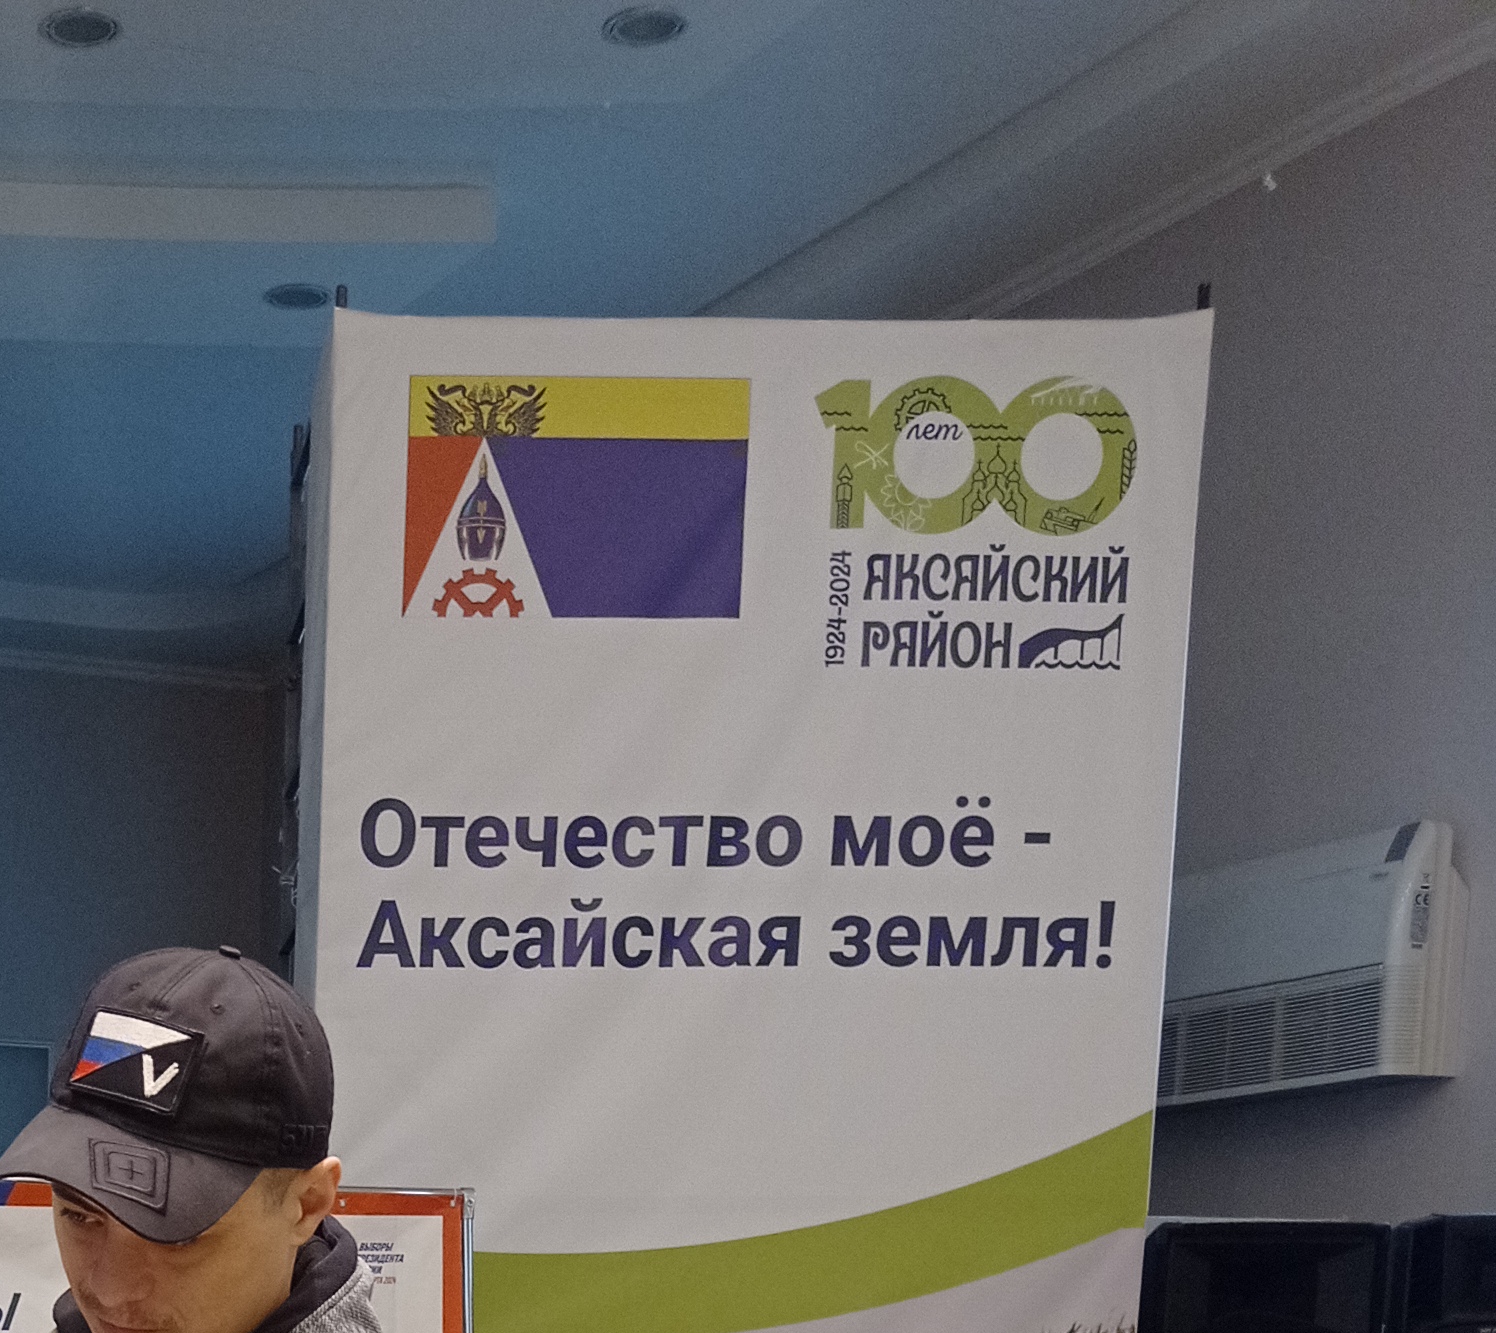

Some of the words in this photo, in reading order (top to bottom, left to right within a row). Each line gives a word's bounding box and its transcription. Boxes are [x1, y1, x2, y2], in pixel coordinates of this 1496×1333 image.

[906, 422, 963, 440] лет
[825, 550, 852, 668] 1924-2024
[359, 798, 803, 868] Отечество
[830, 796, 996, 868] моё
[357, 898, 801, 969] Аксайская
[829, 900, 1116, 969] земля!
